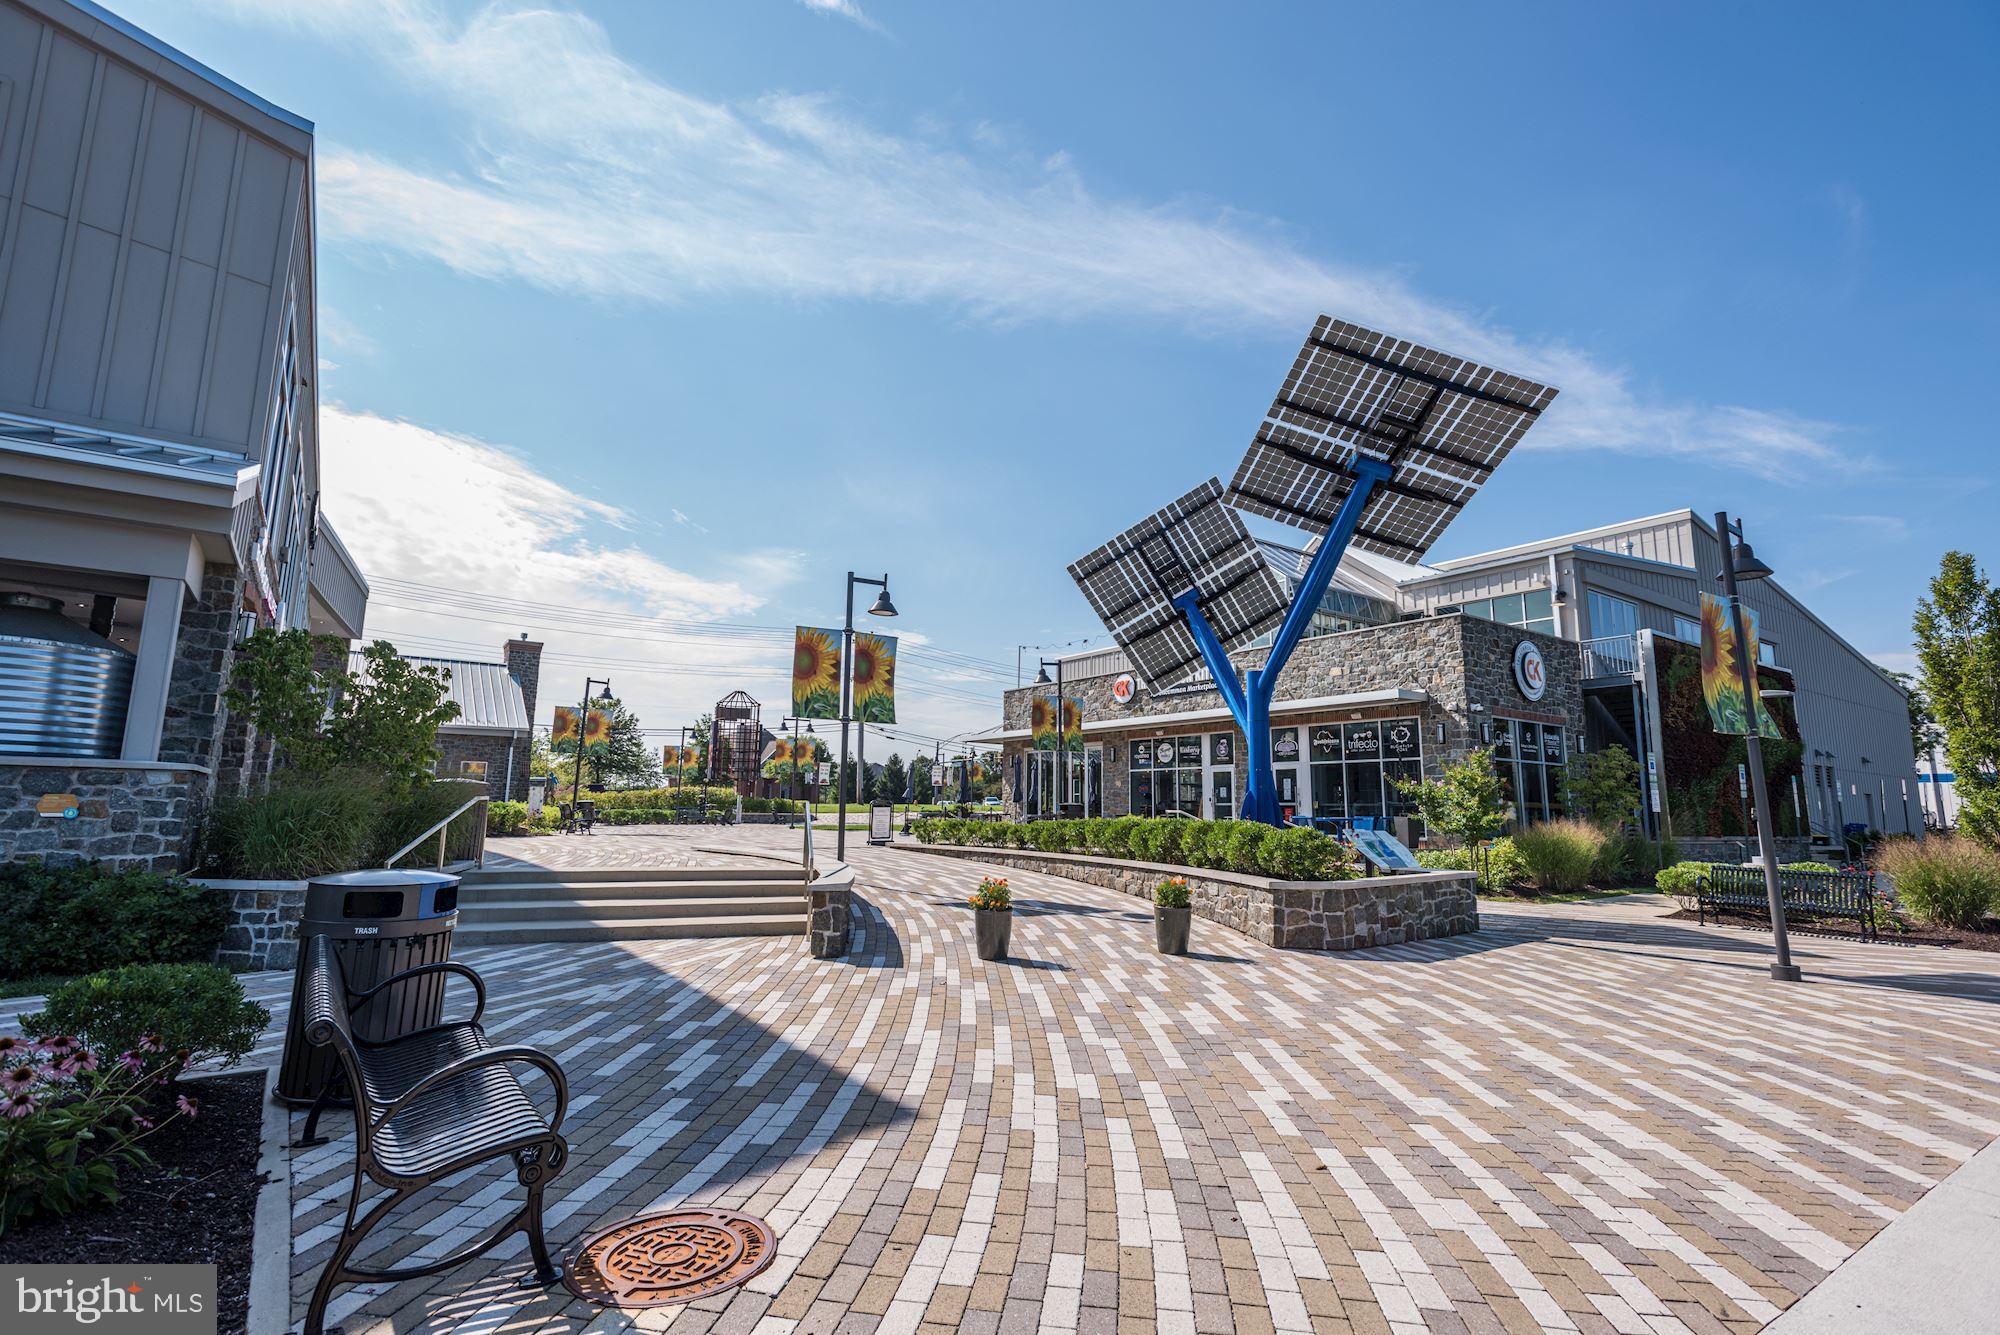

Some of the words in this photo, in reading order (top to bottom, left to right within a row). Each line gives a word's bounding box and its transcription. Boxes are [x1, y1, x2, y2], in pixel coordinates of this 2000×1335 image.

[1187, 682, 1217, 692] Marketplac
[354, 927, 378, 935] TRASH
[739, 1226, 761, 1265] HOWARD
